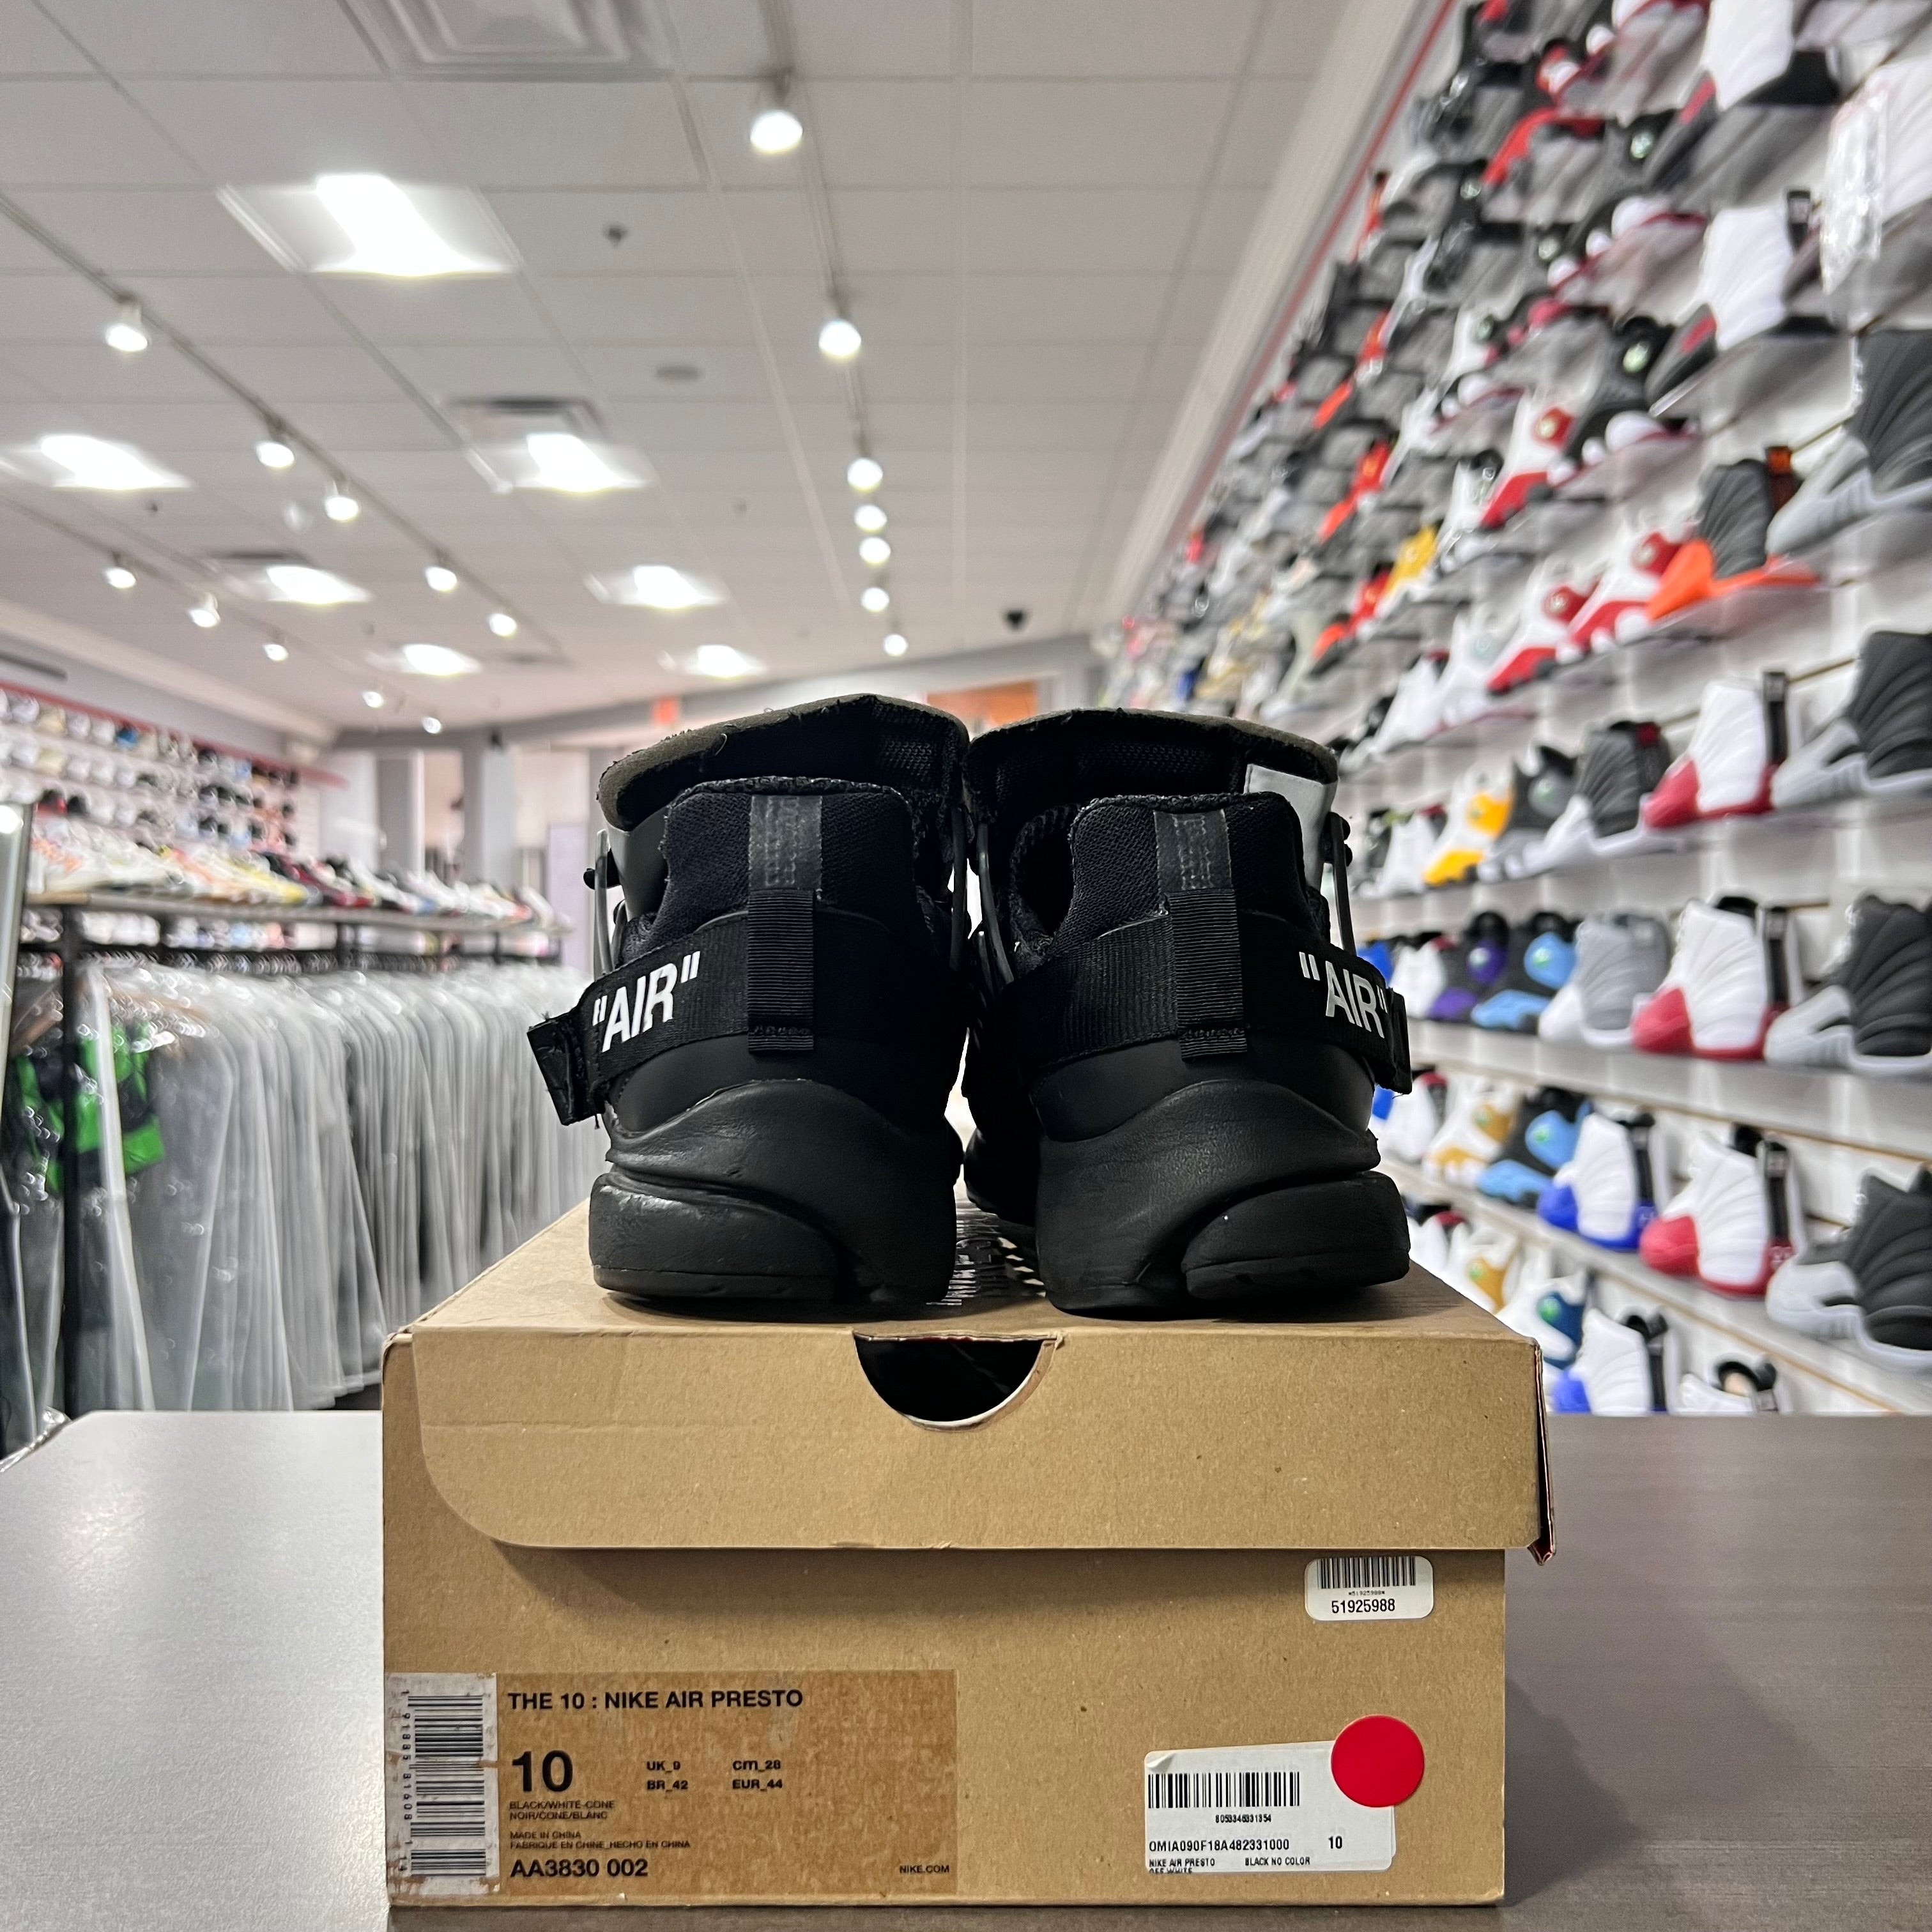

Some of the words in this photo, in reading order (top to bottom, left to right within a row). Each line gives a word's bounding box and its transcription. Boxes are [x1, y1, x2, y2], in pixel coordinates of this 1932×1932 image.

[1331, 1598, 1395, 1614] 51925988
[508, 1692, 553, 1710] THE
[561, 1692, 585, 1710] 10
[604, 1691, 659, 1708] NIKE
[665, 1690, 703, 1708] AIR
[711, 1689, 803, 1707] PRESTO
[512, 1749, 573, 1792] 10
[647, 1779, 688, 1793] BR_42
[732, 1779, 783, 1791] EUR_44
[1215, 1814, 1271, 1823] 8053346331354
[1328, 1836, 1343, 1850] 10
[510, 1859, 599, 1877] AA3830
[607, 1858, 648, 1876] 002
[1149, 1859, 1167, 1867] NIKE
[1184, 1858, 1215, 1866] PRESTO
[1245, 1857, 1269, 1866] BLACK
[1271, 1857, 1282, 1866] NO
[1285, 1856, 1310, 1865] COLOR
[900, 1865, 949, 1873] NIKE.COM
